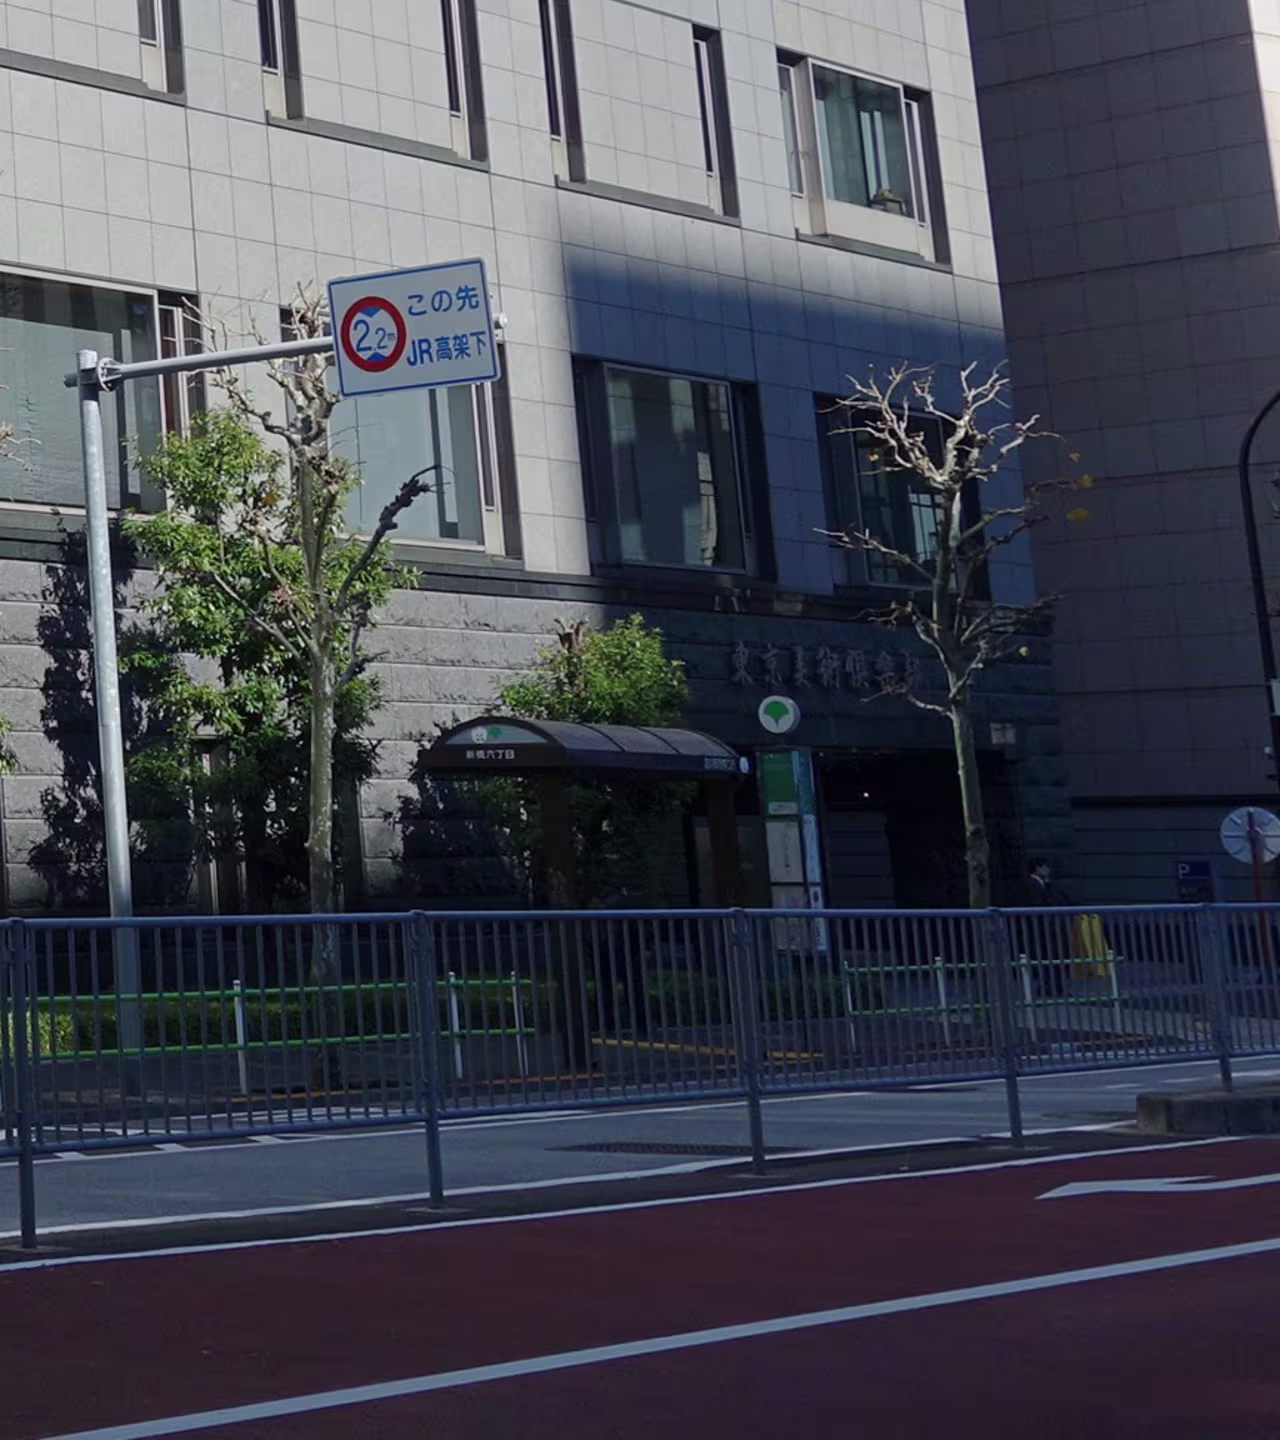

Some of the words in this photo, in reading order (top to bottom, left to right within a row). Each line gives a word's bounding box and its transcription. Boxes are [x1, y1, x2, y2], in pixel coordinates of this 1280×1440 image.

[407, 285, 480, 316] この先
[406, 330, 487, 367] JR高架下
[1177, 863, 1191, 880] P
